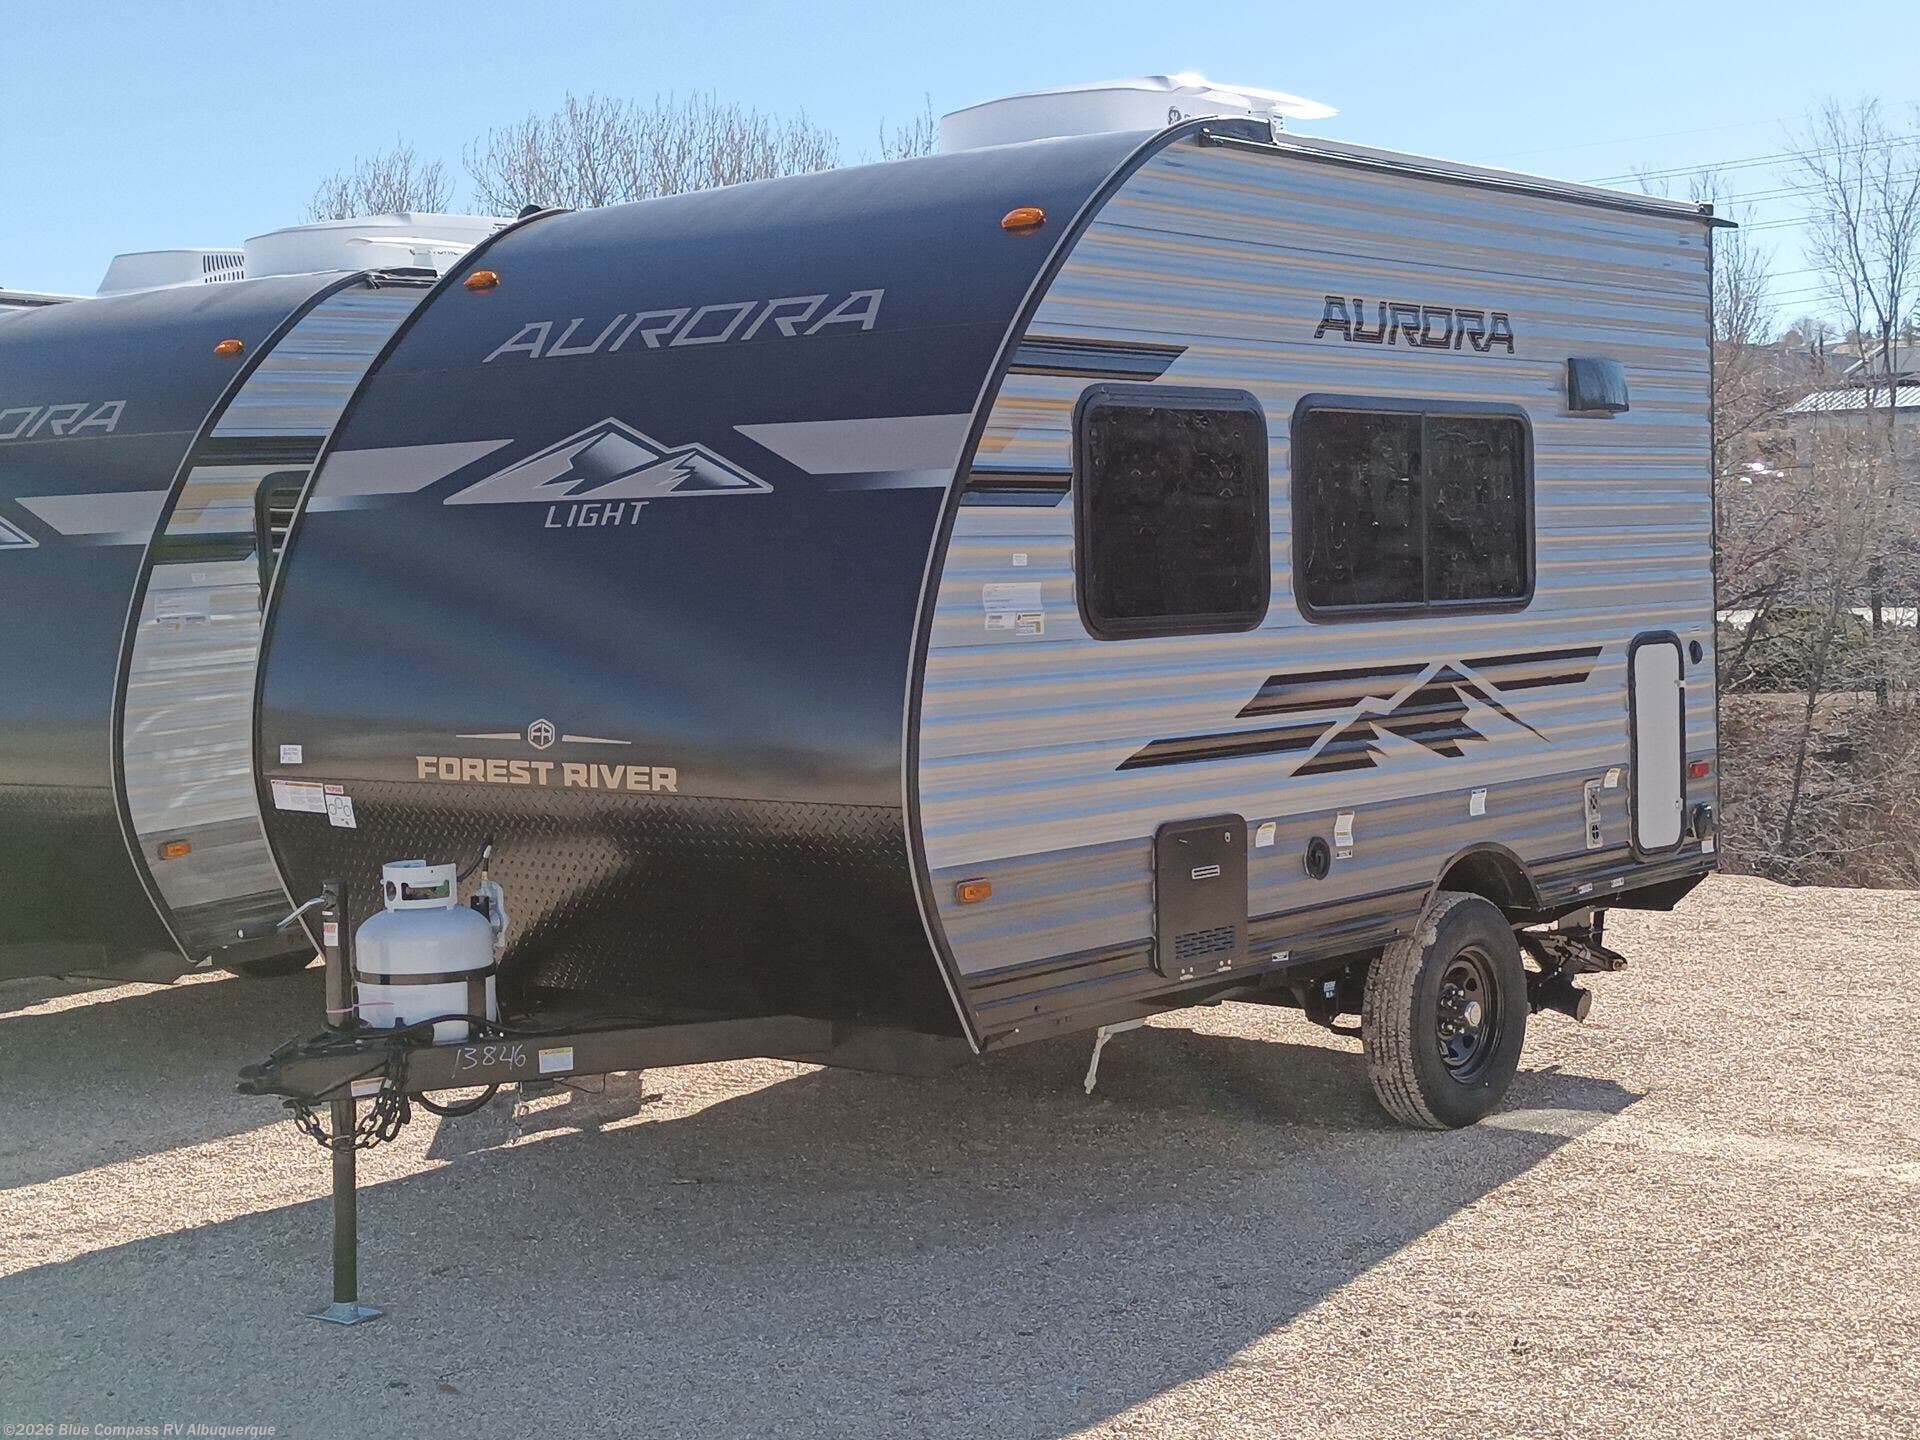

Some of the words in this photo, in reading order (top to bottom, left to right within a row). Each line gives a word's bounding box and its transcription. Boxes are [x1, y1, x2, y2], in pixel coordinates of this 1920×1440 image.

[483, 288, 885, 363] AURORA
[1314, 295, 1515, 354] AURORA
[544, 500, 650, 529] LIGHT
[416, 755, 555, 786] FOREST
[561, 761, 678, 793] RIVER
[451, 1044, 527, 1079] 13846
